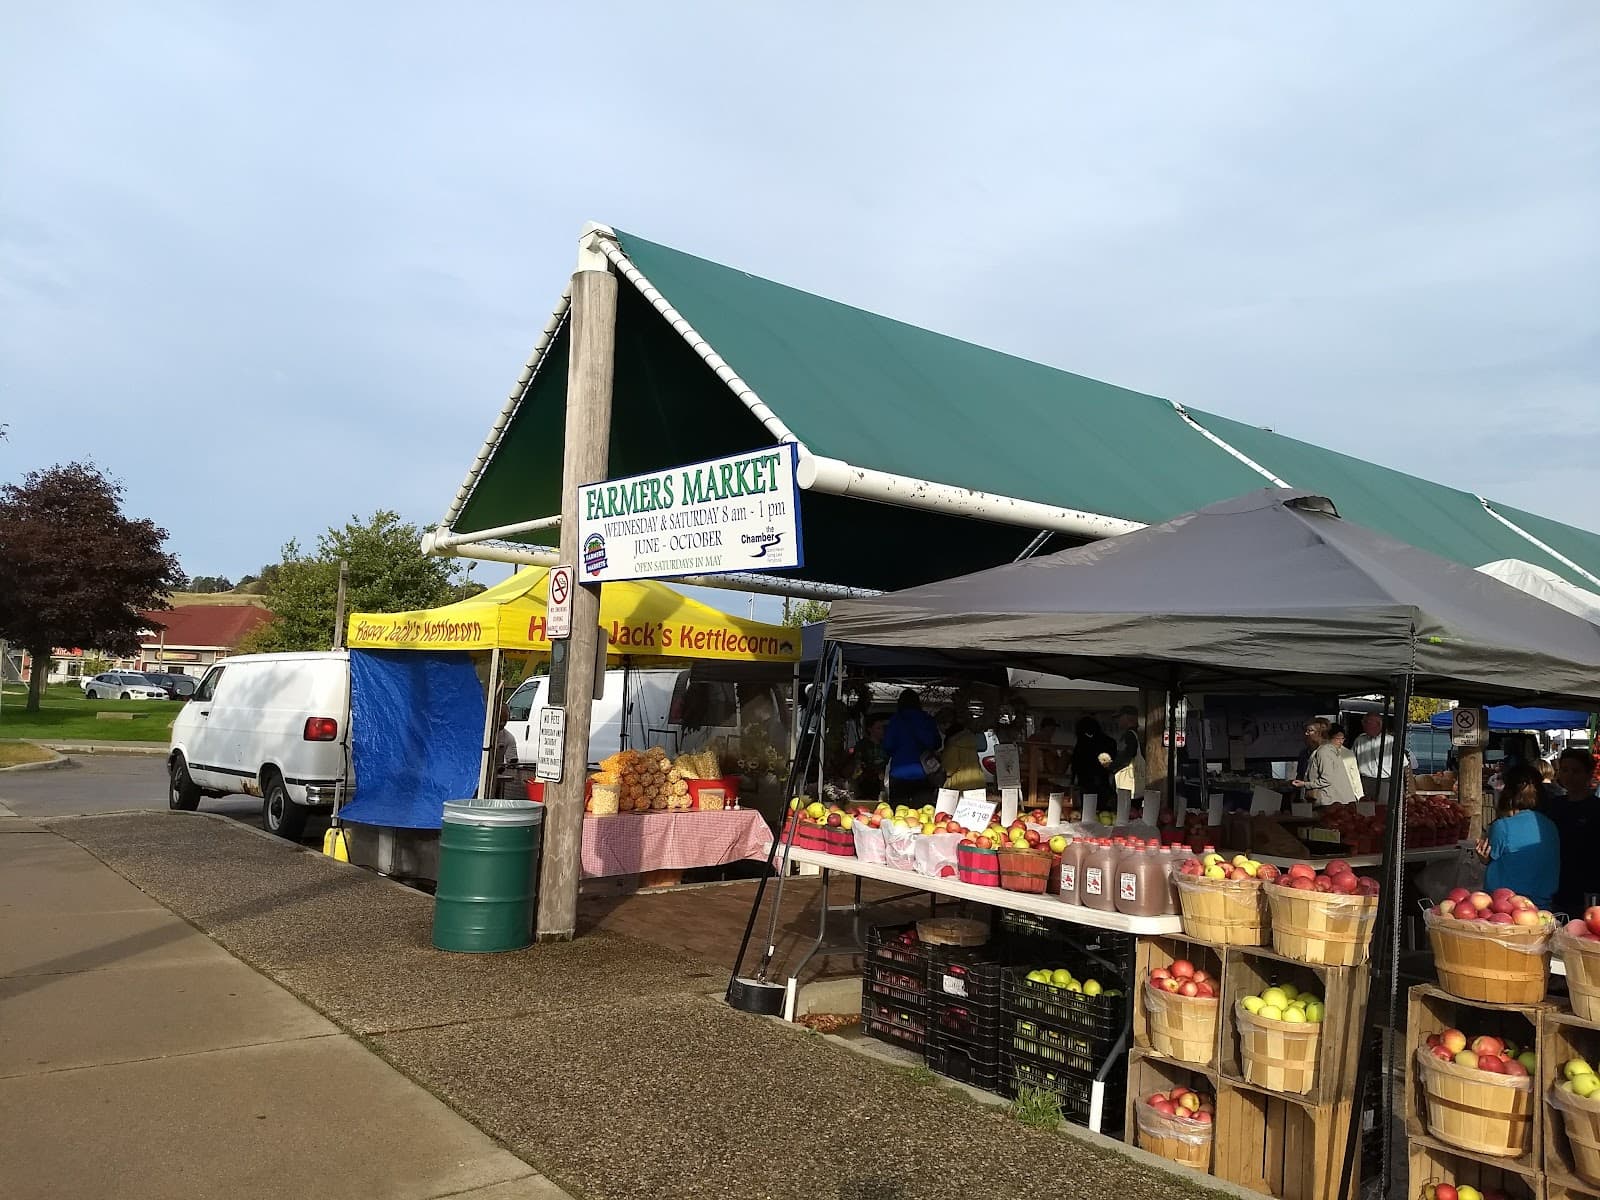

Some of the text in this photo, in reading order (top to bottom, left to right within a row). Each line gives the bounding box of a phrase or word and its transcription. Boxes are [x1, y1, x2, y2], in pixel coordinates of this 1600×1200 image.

[586, 452, 781, 521] FARMERS MARKET
[604, 514, 659, 538] WEDNESDAY
[660, 514, 668, 530] &
[669, 506, 720, 530] SATURDAY
[722, 506, 728, 523] 8
[731, 507, 747, 521] am
[758, 500, 764, 518] 1
[768, 501, 786, 522] pm
[766, 525, 775, 533] the
[633, 537, 660, 559] JUNE
[671, 531, 723, 551] OCTOBER
[634, 554, 722, 573] OPEN SATURDAYS IN MAY
[355, 619, 482, 642] Happy Jack's Kettlecorn
[608, 621, 779, 655] Jack's Kettlecorn
